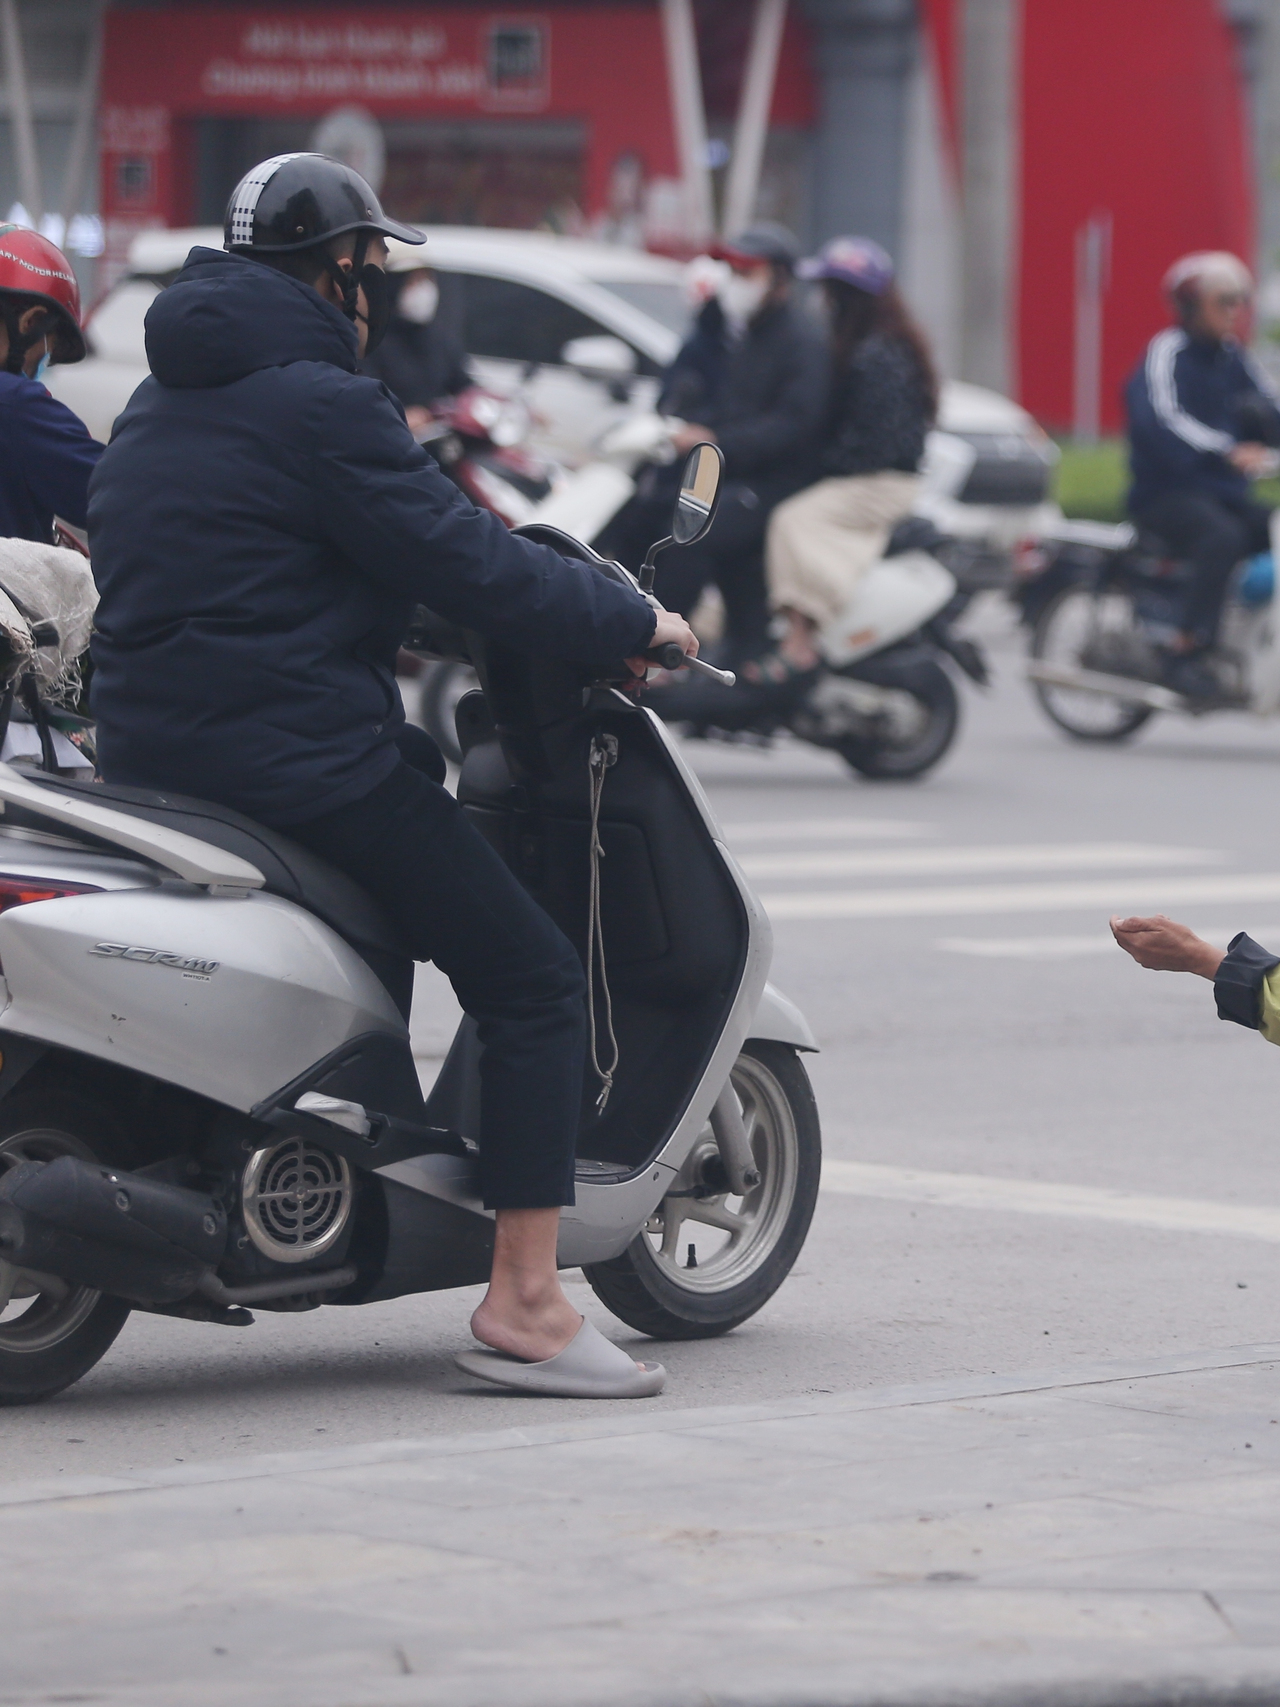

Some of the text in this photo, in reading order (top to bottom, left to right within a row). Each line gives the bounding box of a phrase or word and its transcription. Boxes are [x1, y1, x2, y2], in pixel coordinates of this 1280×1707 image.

[0, 249, 18, 262] ARY
[19, 259, 51, 276] MOTOR
[89, 942, 219, 974] SCR 110
